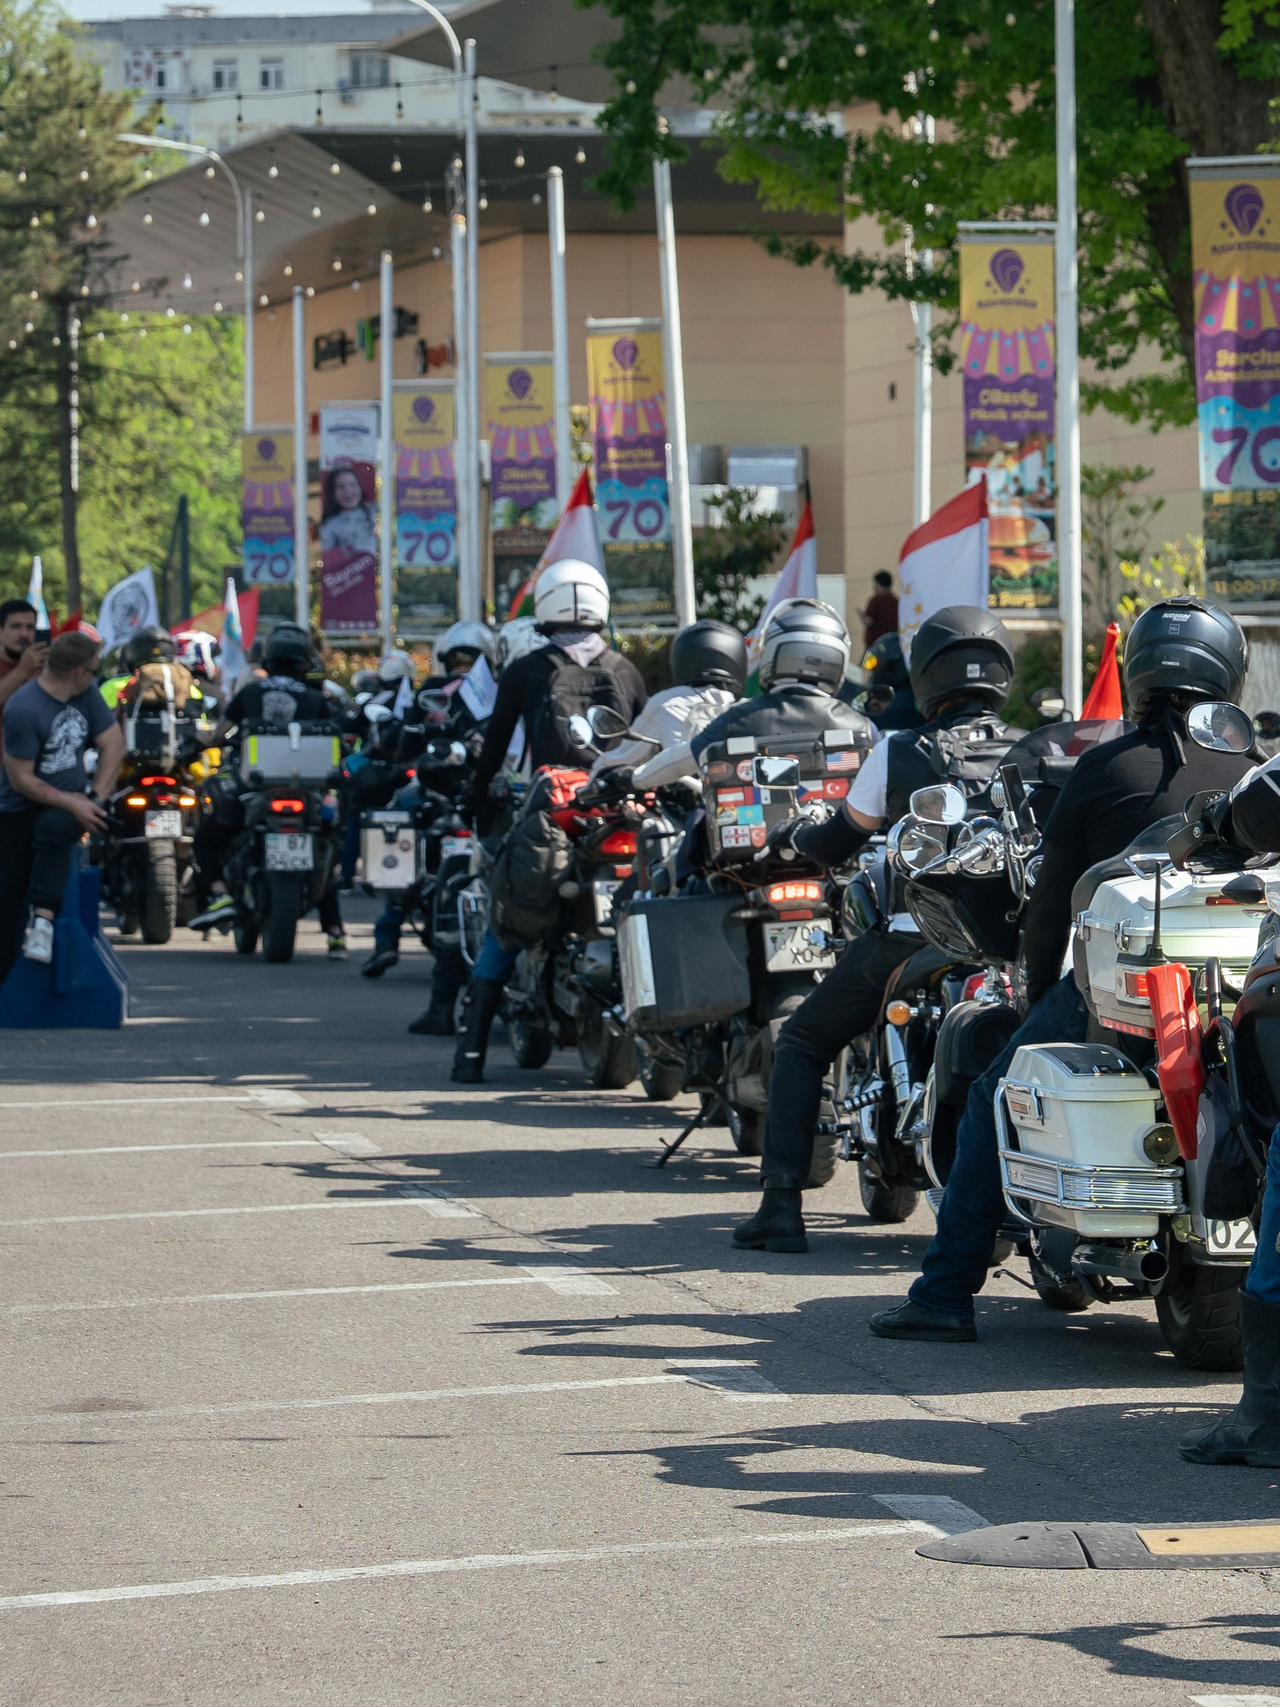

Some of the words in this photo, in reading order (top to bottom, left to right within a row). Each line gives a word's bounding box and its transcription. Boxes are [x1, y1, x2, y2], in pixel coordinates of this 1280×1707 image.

[605, 499, 665, 539] 70
[403, 530, 451, 563] 70
[251, 553, 290, 580] 70
